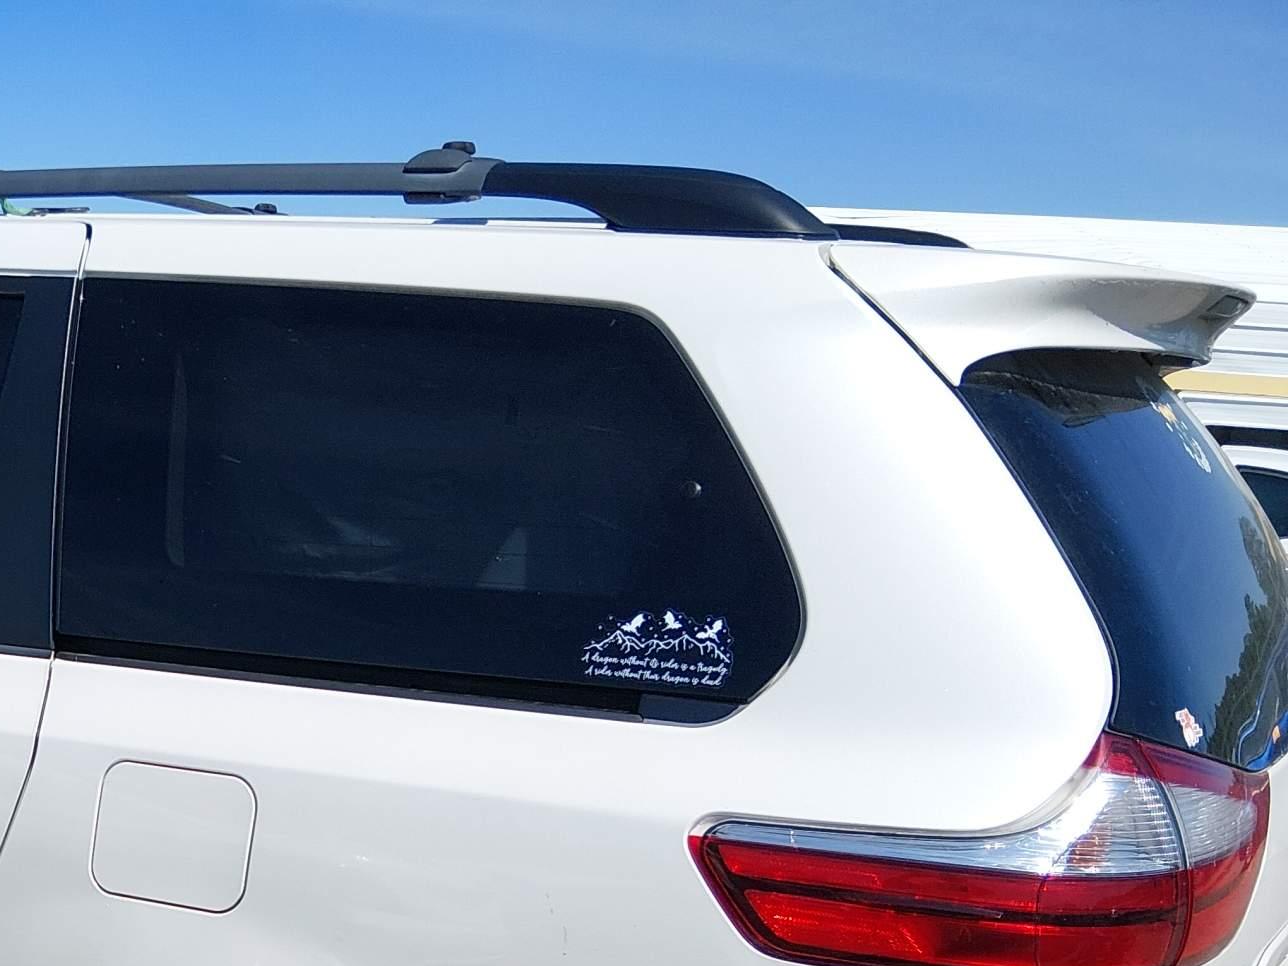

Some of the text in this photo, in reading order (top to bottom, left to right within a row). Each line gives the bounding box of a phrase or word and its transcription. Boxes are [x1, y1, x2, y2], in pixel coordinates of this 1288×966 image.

[581, 651, 590, 663] A
[591, 651, 619, 665] dragon
[620, 655, 650, 667] without
[584, 664, 593, 677] A
[613, 667, 642, 680] without
[661, 671, 690, 685] dragon
